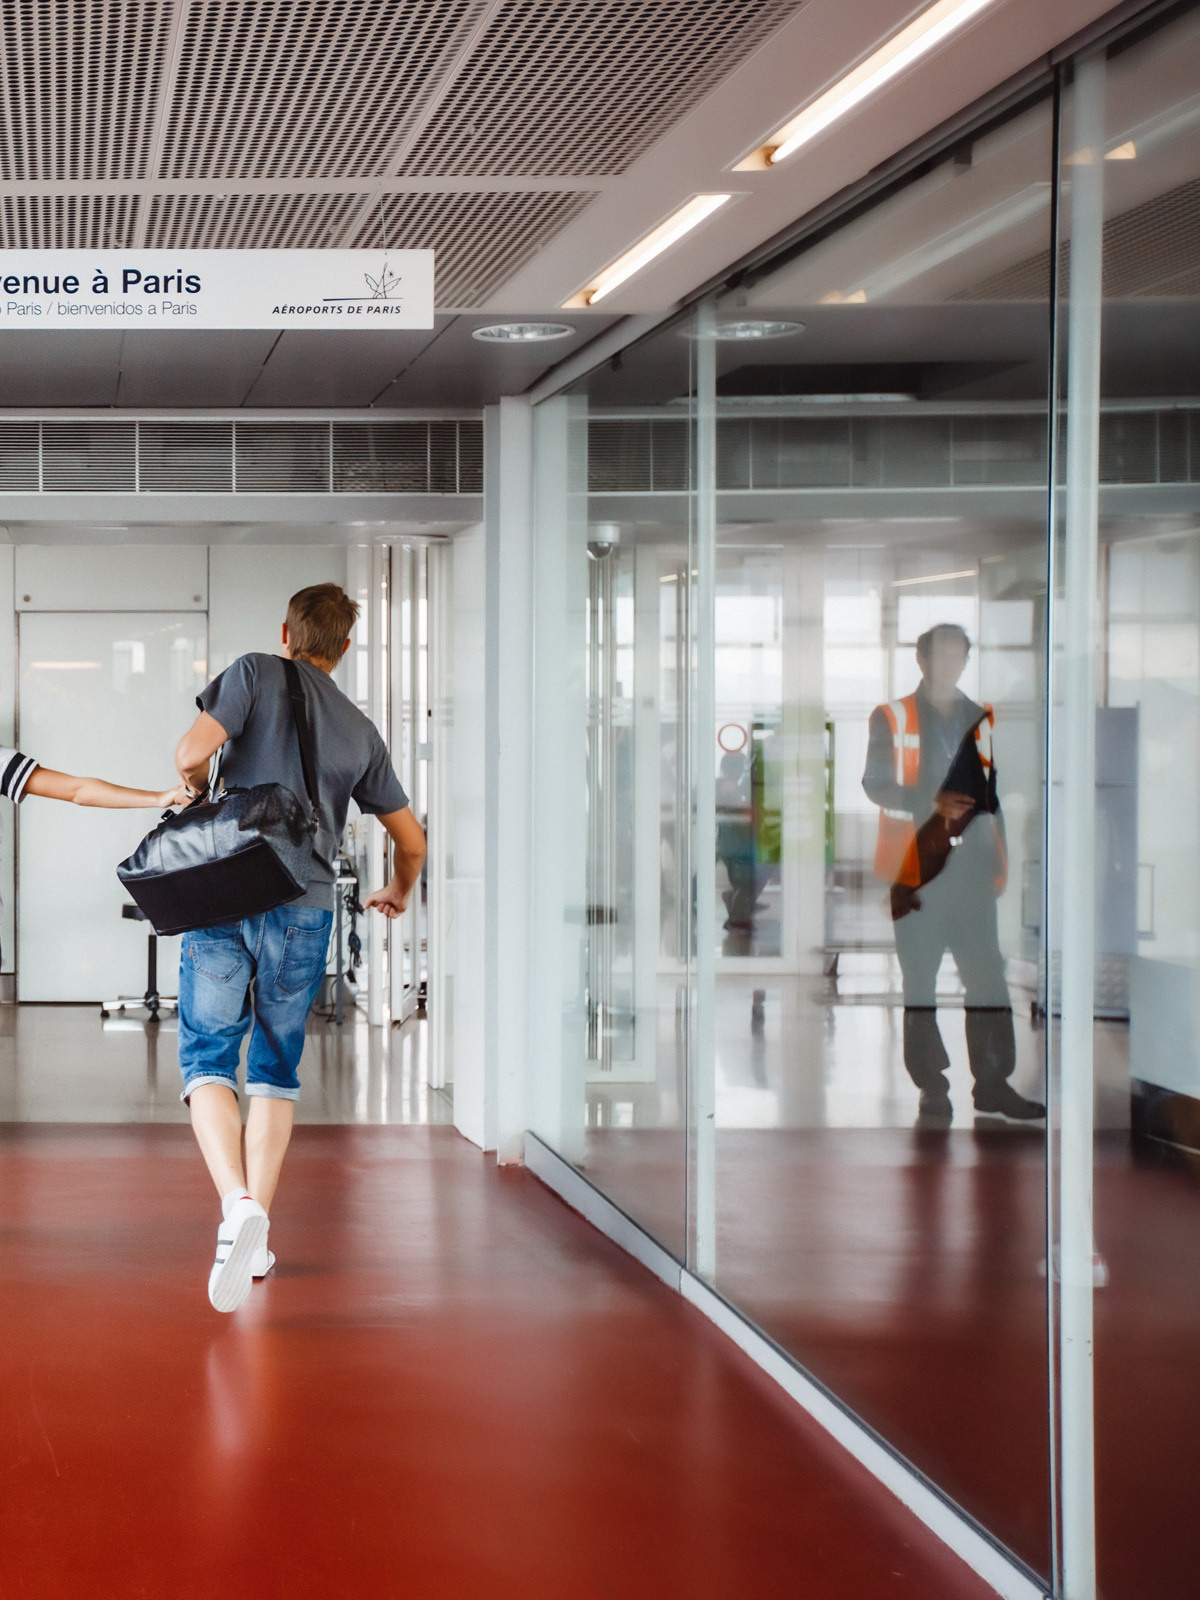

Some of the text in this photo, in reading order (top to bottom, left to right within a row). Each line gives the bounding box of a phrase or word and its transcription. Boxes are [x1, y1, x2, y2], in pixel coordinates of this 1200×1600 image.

[92, 268, 109, 294] à
[122, 268, 202, 294] Paris
[7, 302, 42, 315] Paris
[46, 302, 53, 316] /
[57, 301, 143, 315] bienvenidos
[148, 304, 158, 315] a
[162, 301, 198, 315] Paris
[272, 303, 401, 314] AÉROPORTS DE PARIS
